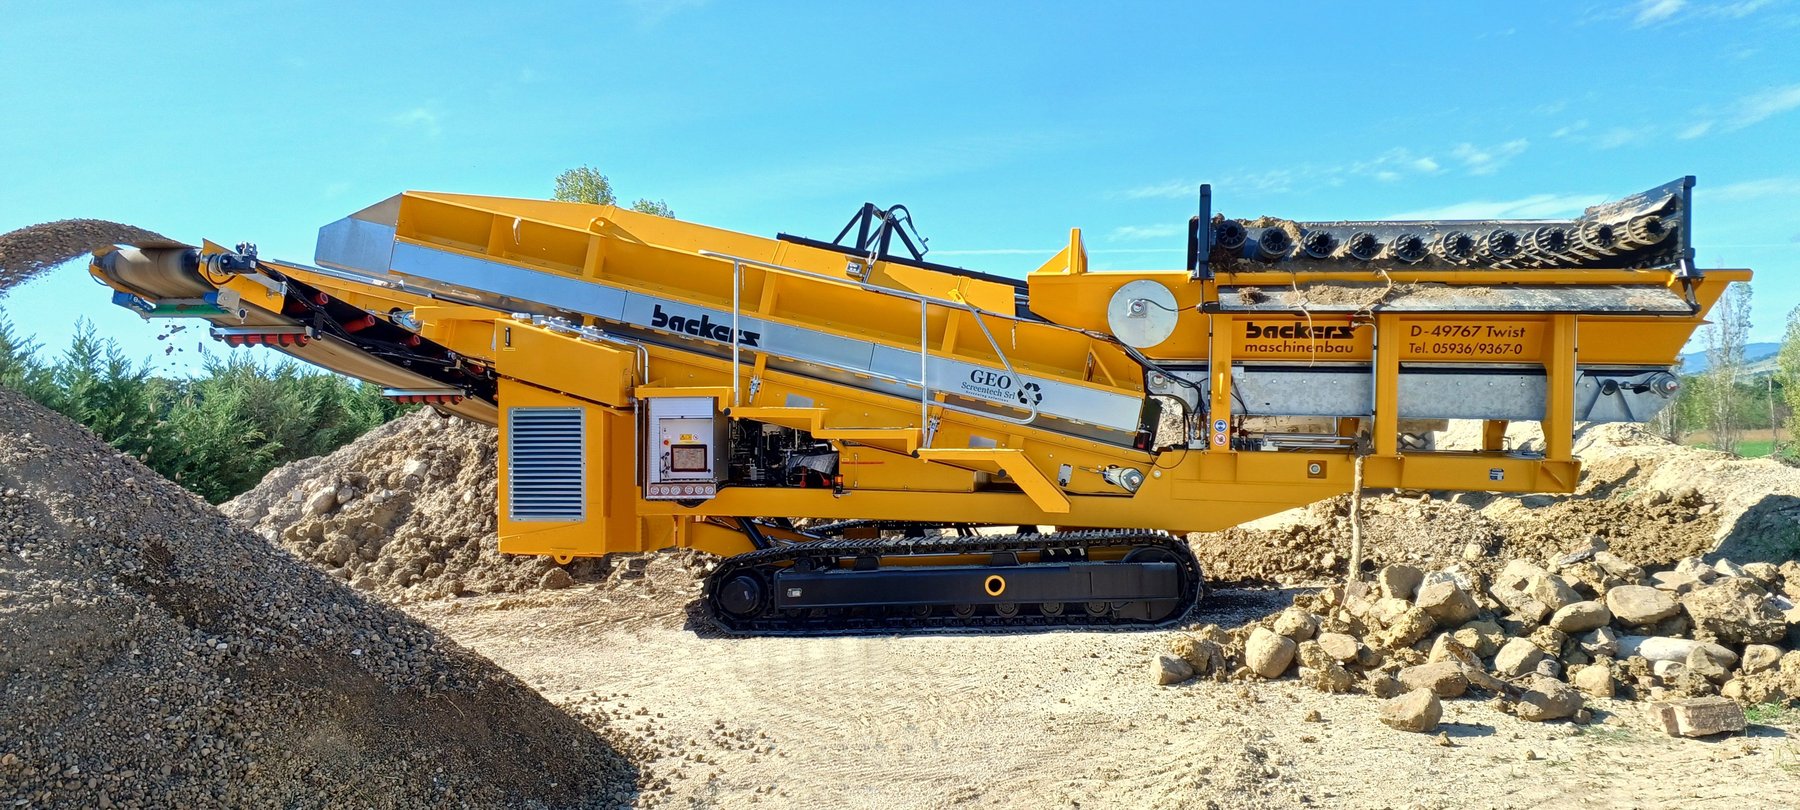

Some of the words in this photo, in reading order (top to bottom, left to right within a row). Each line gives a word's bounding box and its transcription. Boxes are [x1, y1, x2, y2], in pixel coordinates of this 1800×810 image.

[651, 304, 760, 347] backers
[1246, 322, 1354, 339] backers
[1486, 326, 1526, 338] Twist
[1245, 341, 1353, 353] maschinenbau
[1409, 342, 1428, 354] Tel.
[1433, 342, 1523, 355] 05936/9367-0
[970, 369, 1011, 389] GEO
[961, 381, 1003, 398] Screentech
[1003, 390, 1016, 400] Srl
